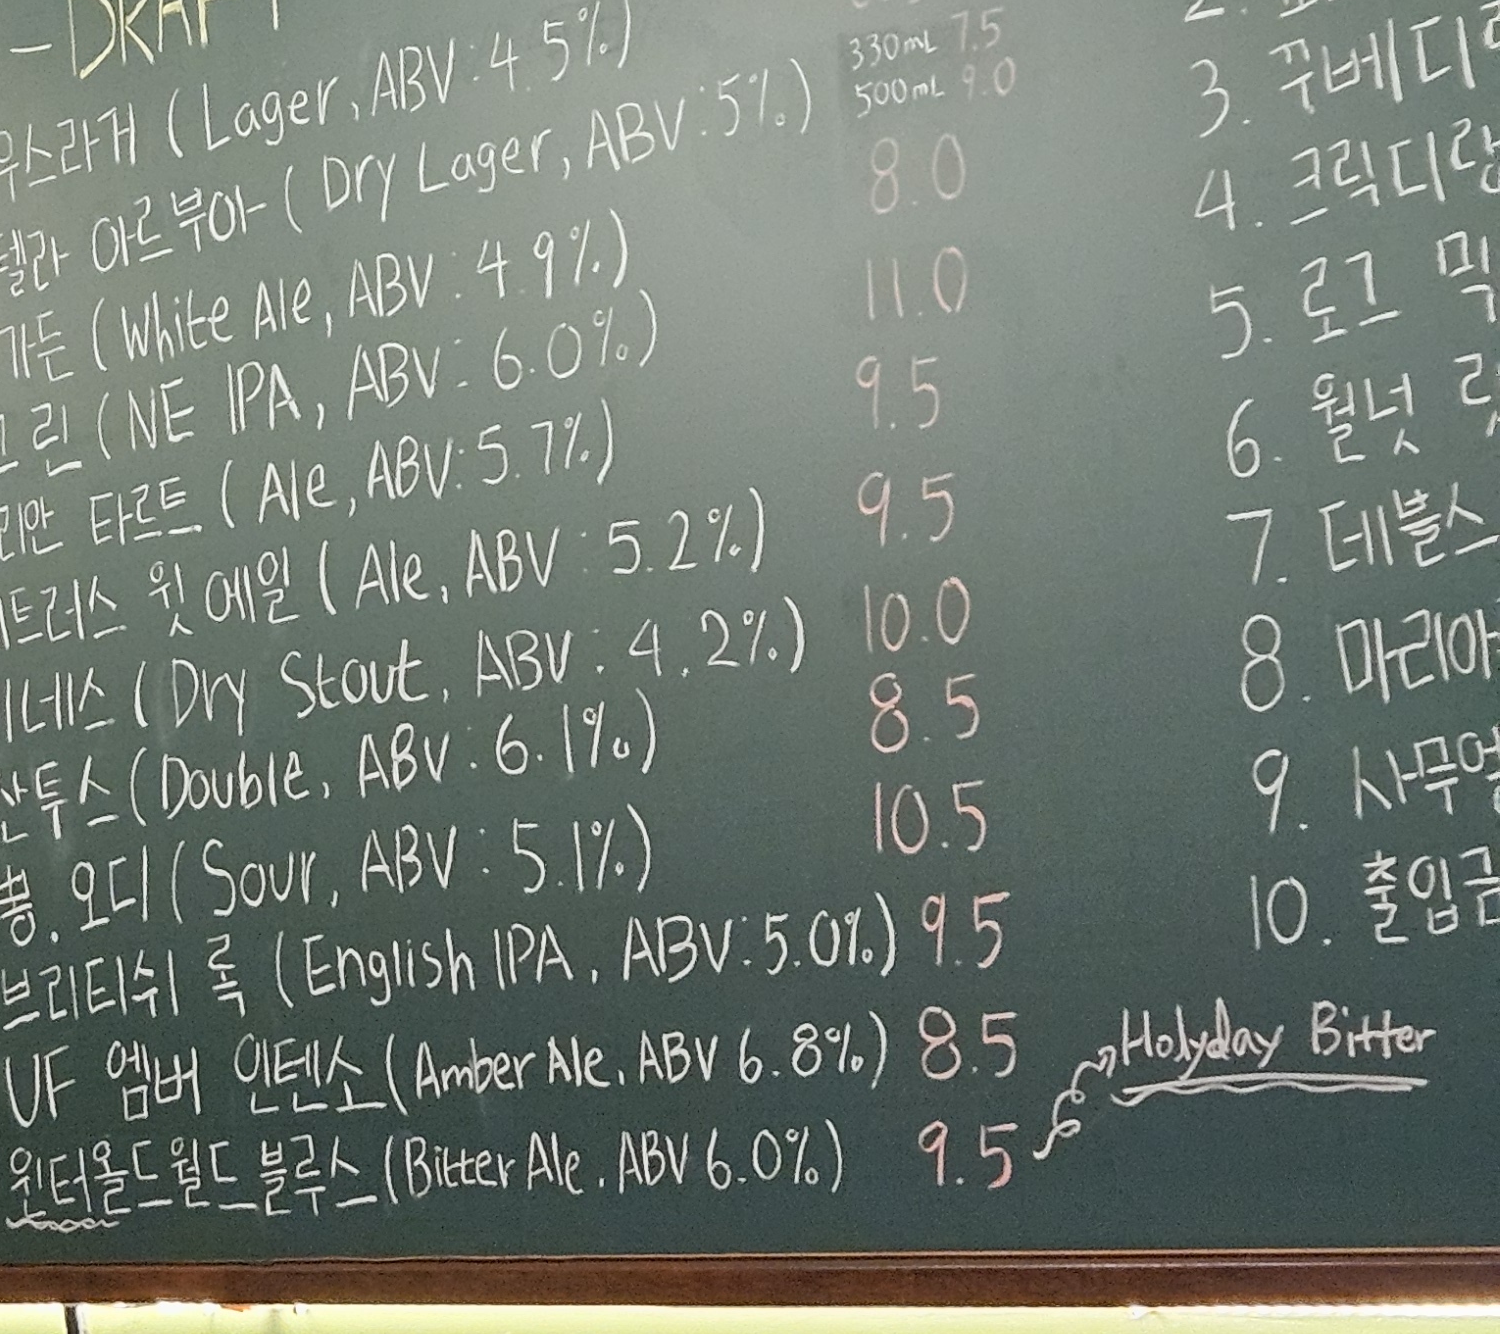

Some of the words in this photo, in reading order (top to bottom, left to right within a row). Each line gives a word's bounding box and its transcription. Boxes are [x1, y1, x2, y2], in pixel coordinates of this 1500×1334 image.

[951, 7, 1003, 53] 7.5
[962, 56, 1016, 100] 9.0
[870, 133, 966, 214] 8.0
[865, 246, 968, 319] 11.0
[1300, 250, 1401, 344] 로그
[856, 355, 941, 429] 9.5
[89, 476, 202, 546] 타르트
[857, 471, 954, 546] 9.5
[864, 577, 972, 652] 10.0
[868, 671, 980, 754] 8.5
[873, 780, 987, 854] 10.5
[920, 891, 1011, 969] 9.5
[1251, 875, 1331, 950] 10.
[917, 1005, 1018, 1081] 8.5
[1309, 1000, 1436, 1061] Bitter
[3, 1045, 76, 1128] UF
[105, 1039, 201, 1122] 엠버
[640, 1029, 719, 1084] ABV
[619, 1129, 688, 1194] ABV
[917, 1120, 1018, 1189] 9.5
